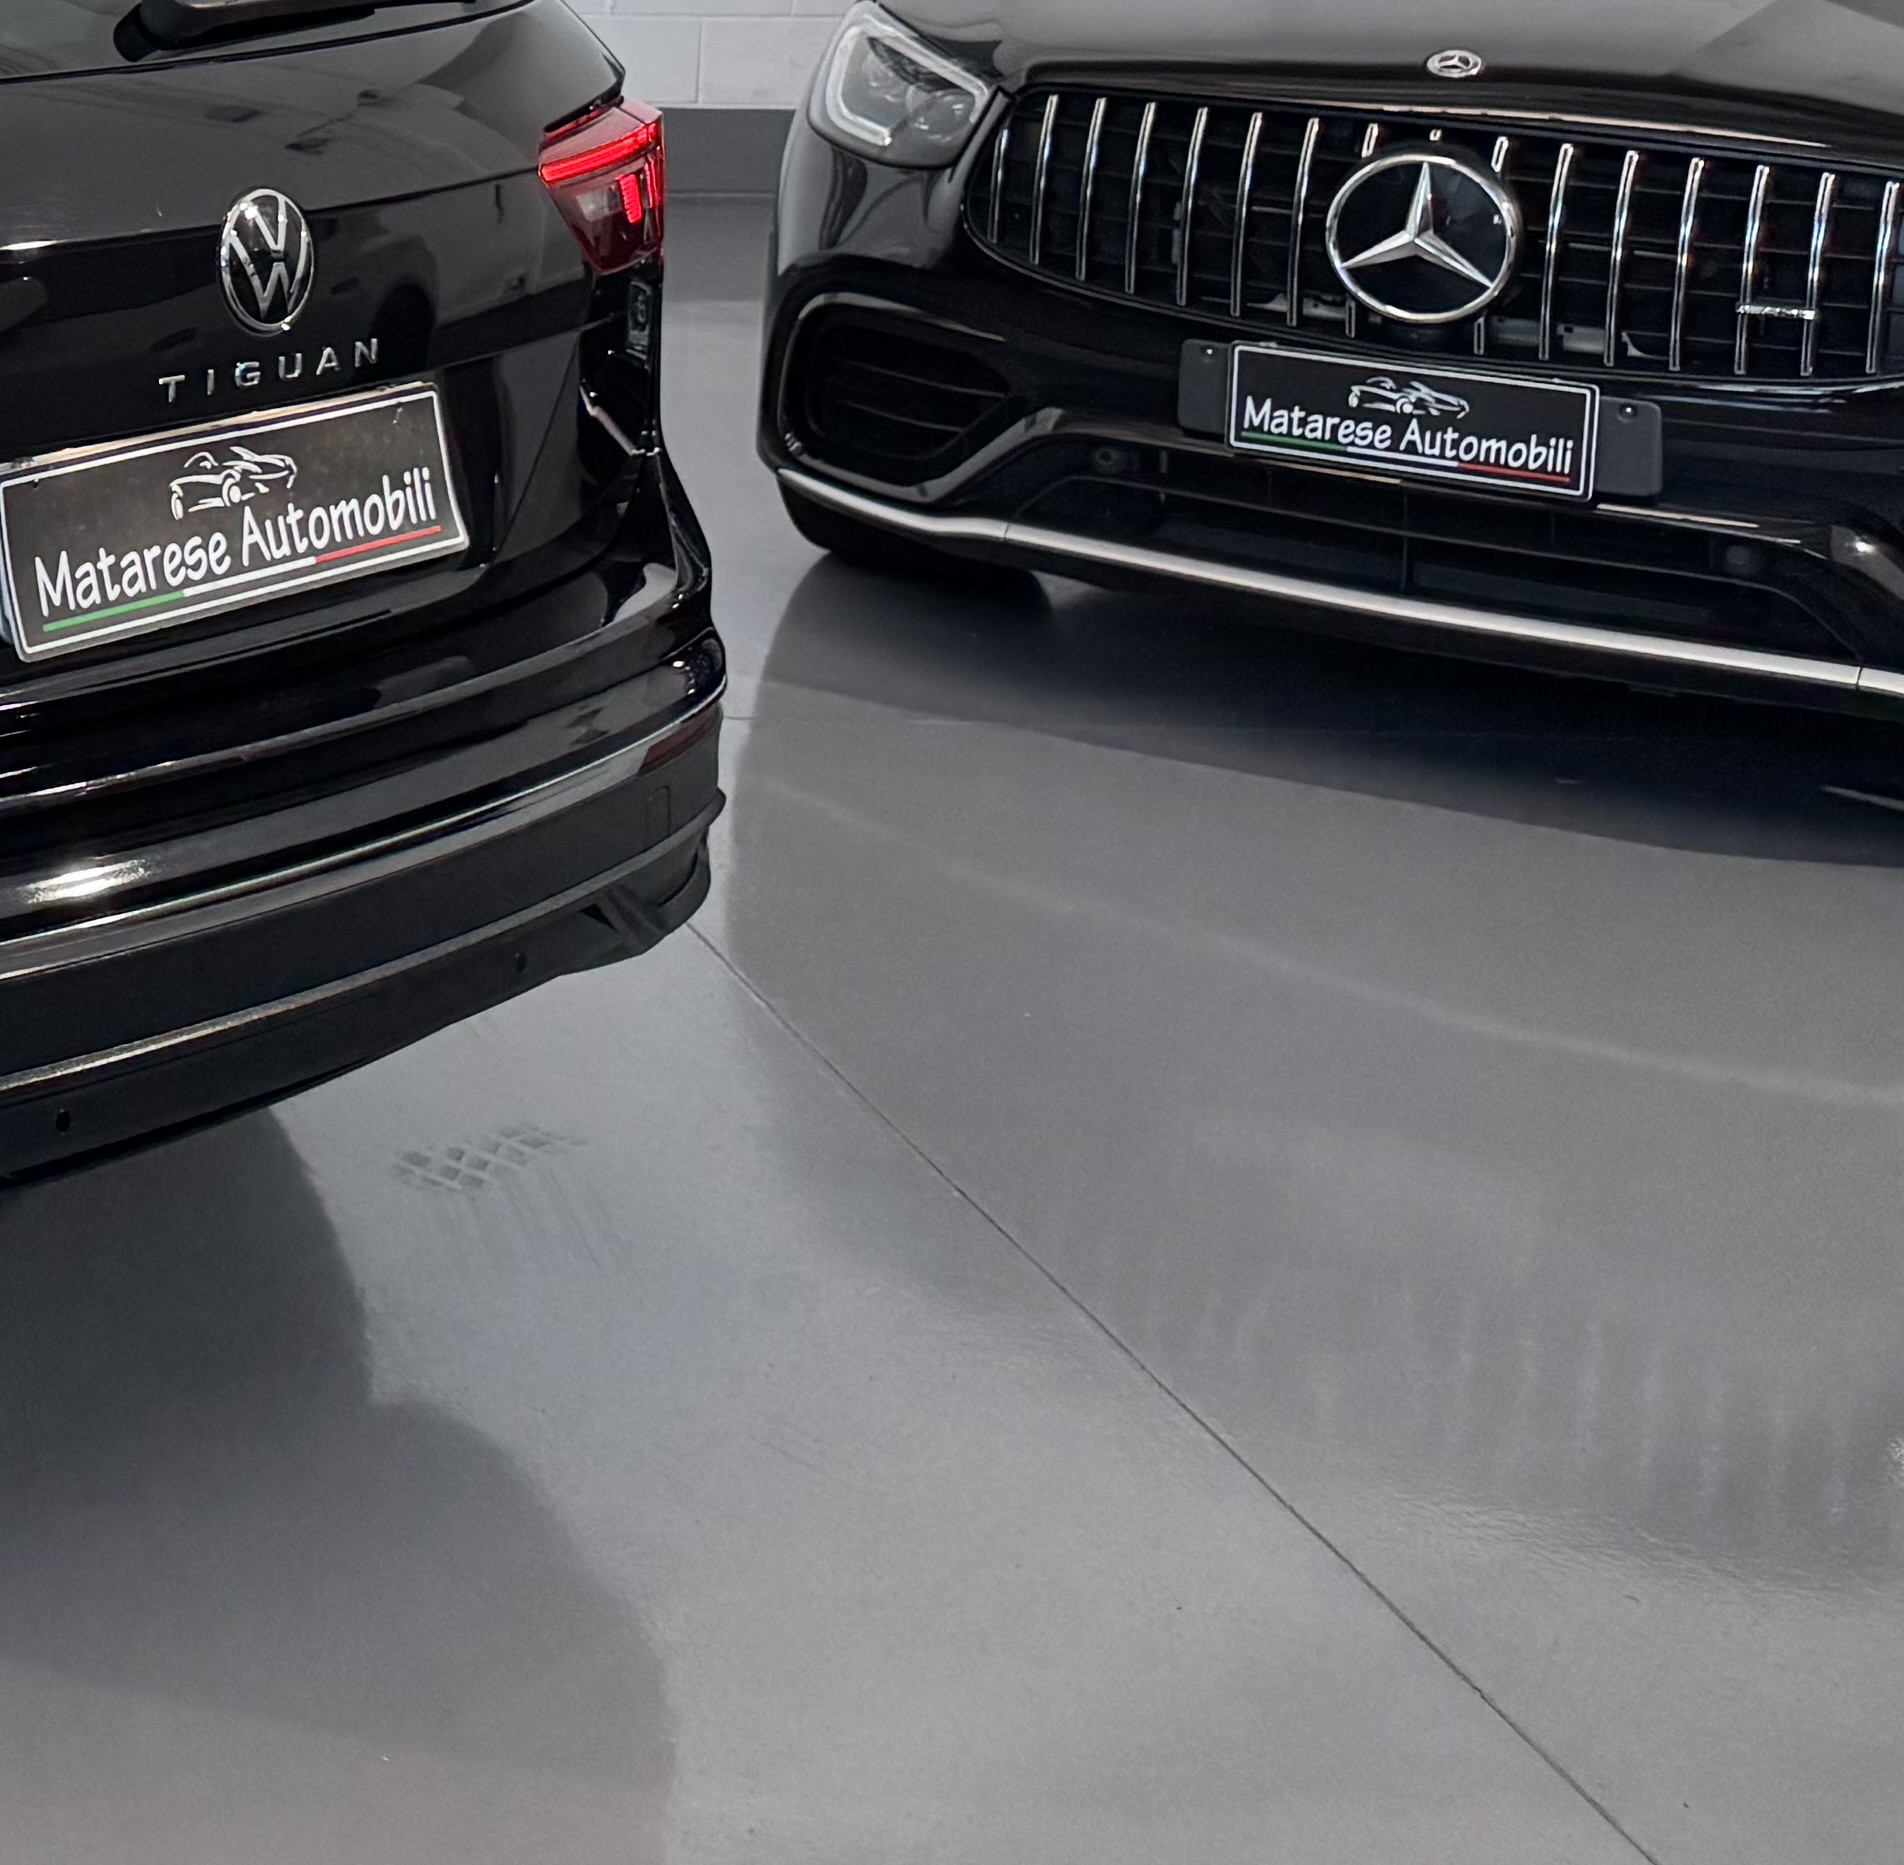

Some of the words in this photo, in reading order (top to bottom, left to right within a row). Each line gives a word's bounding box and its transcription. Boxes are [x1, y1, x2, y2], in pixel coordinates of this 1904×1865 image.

[159, 337, 379, 403] TIGUAN
[1243, 395, 1392, 448] Matarese
[1399, 418, 1573, 474] Automobili
[34, 531, 231, 618] Matarese
[241, 467, 437, 567] Automobili
